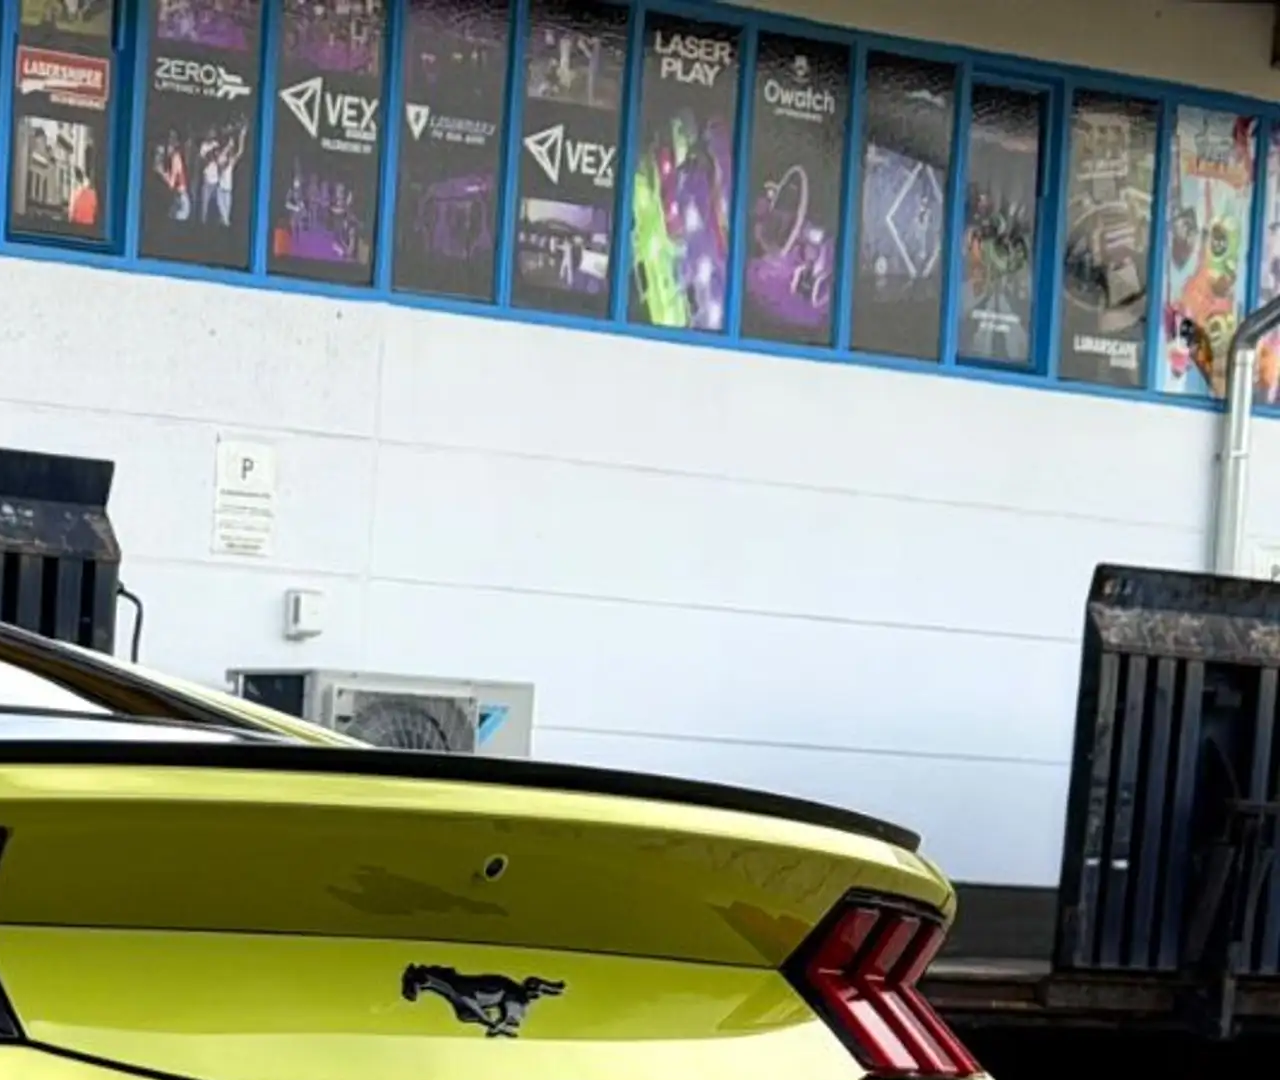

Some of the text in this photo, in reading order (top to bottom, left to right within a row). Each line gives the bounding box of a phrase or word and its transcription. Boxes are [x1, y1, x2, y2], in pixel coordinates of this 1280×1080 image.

[654, 30, 732, 66] LASER
[155, 57, 217, 86] ZERO
[661, 57, 721, 88] PLAY
[325, 92, 379, 131] VEX
[565, 140, 617, 180] VEX
[241, 457, 254, 480] P
